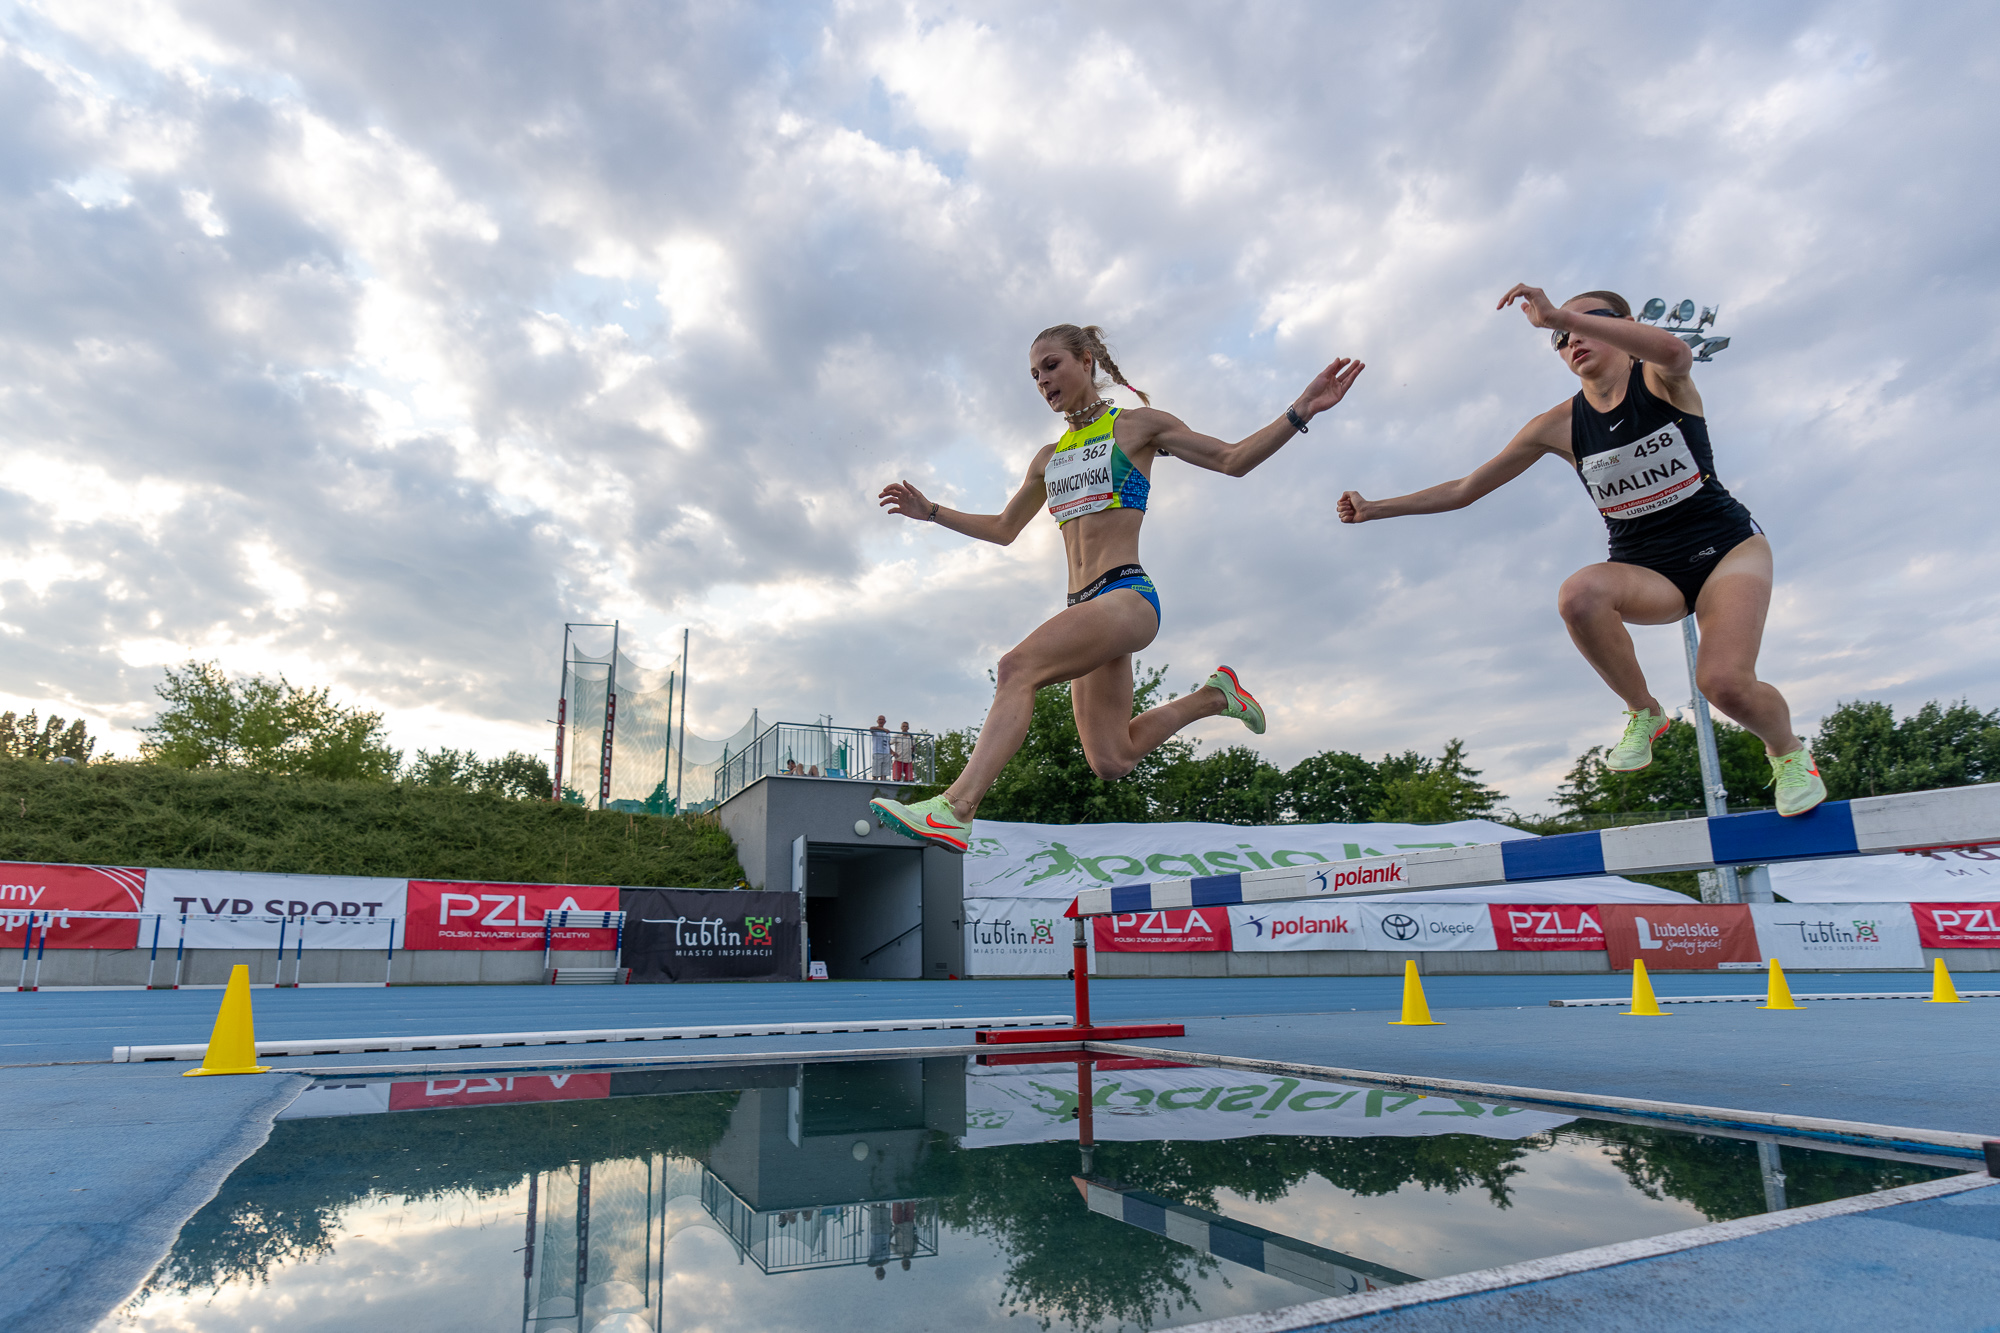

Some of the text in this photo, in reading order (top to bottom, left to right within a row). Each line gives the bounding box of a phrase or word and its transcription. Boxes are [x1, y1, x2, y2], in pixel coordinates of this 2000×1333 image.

[1082, 443, 1107, 462] 362
[1633, 432, 1674, 459] 458
[1046, 466, 1110, 499] KRAWCZYŃSKA
[1597, 458, 1688, 500] MALINA
[1626, 494, 1679, 516] LUBLIN 2023
[1627, 493, 1664, 507] Mistrzostwa
[1664, 484, 1683, 495] Polski
[1062, 503, 1092, 518] LUBLIN 2023
[1334, 862, 1403, 892] polanik
[173, 896, 383, 925] TVP SPORT
[1112, 909, 1213, 934] PZLA
[1271, 915, 1349, 940] polanik
[1429, 921, 1475, 936] Okęcie
[1507, 911, 1603, 934] PZLA
[438, 930, 590, 940] POLSKI ZWIĄZEK LEKKIE ATLETYKI
[675, 949, 773, 957] MIASTO INSPIRACJI
